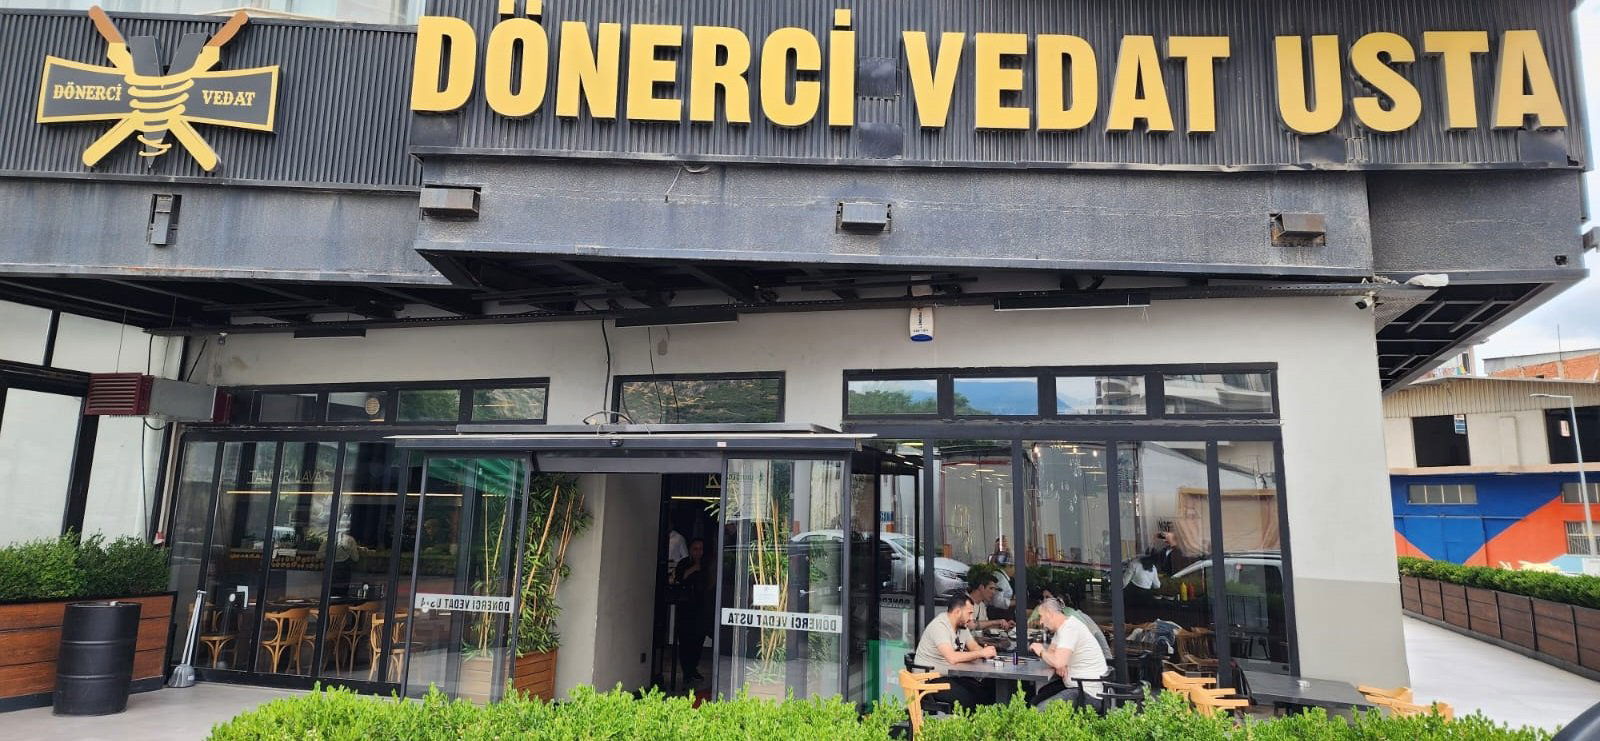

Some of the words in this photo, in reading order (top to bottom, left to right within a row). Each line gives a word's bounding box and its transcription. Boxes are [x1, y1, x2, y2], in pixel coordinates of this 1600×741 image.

[53, 81, 122, 101] DÖNERCİ
[201, 89, 256, 106] VEDAT
[410, 0, 856, 127] DÖNERCİ
[902, 32, 1230, 133] VEDAT
[1274, 30, 1568, 135] USTA
